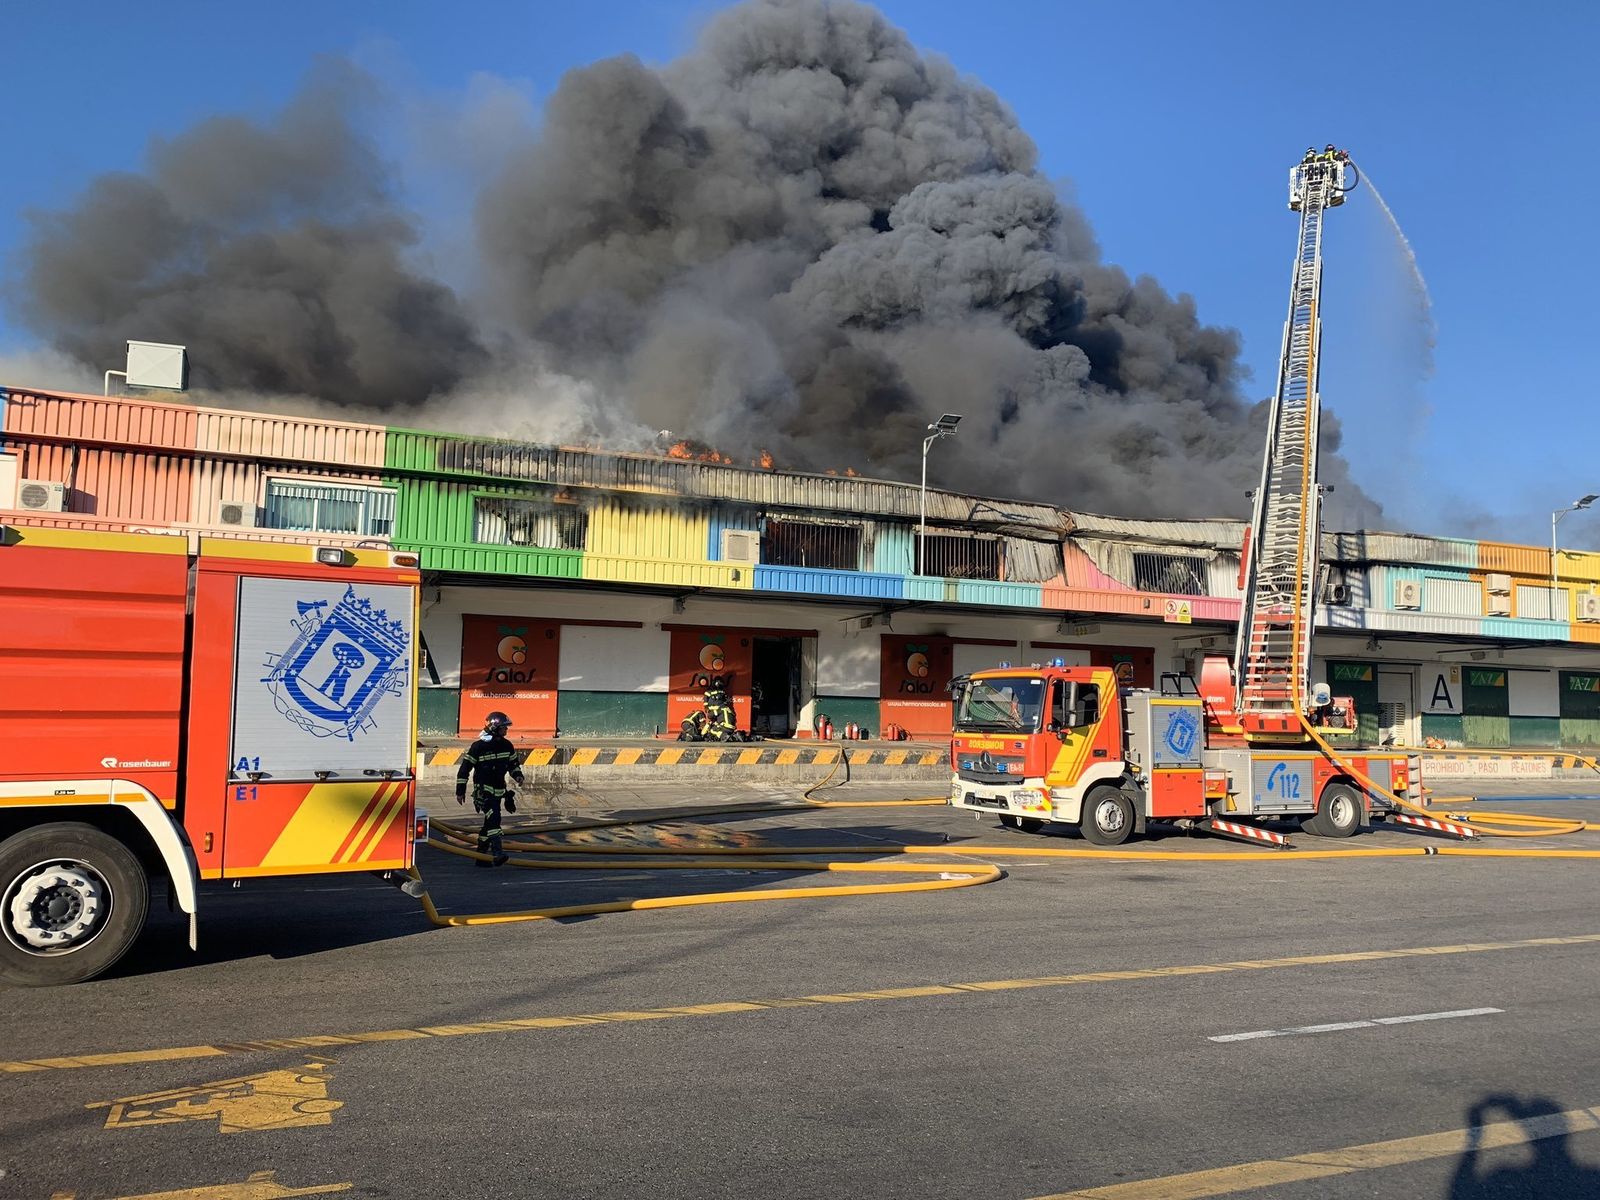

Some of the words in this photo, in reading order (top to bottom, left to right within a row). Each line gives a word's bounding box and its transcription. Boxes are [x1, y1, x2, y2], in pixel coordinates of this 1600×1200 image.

[1430, 673, 1454, 709] A
[118, 759, 171, 768] rosenbauer
[236, 756, 260, 771] A1
[1425, 762, 1464, 773] PROHIBIDO
[1478, 762, 1498, 773] PASO
[1511, 762, 1546, 773] PEATONES
[236, 786, 257, 801] E1
[1280, 773, 1300, 799] 112
